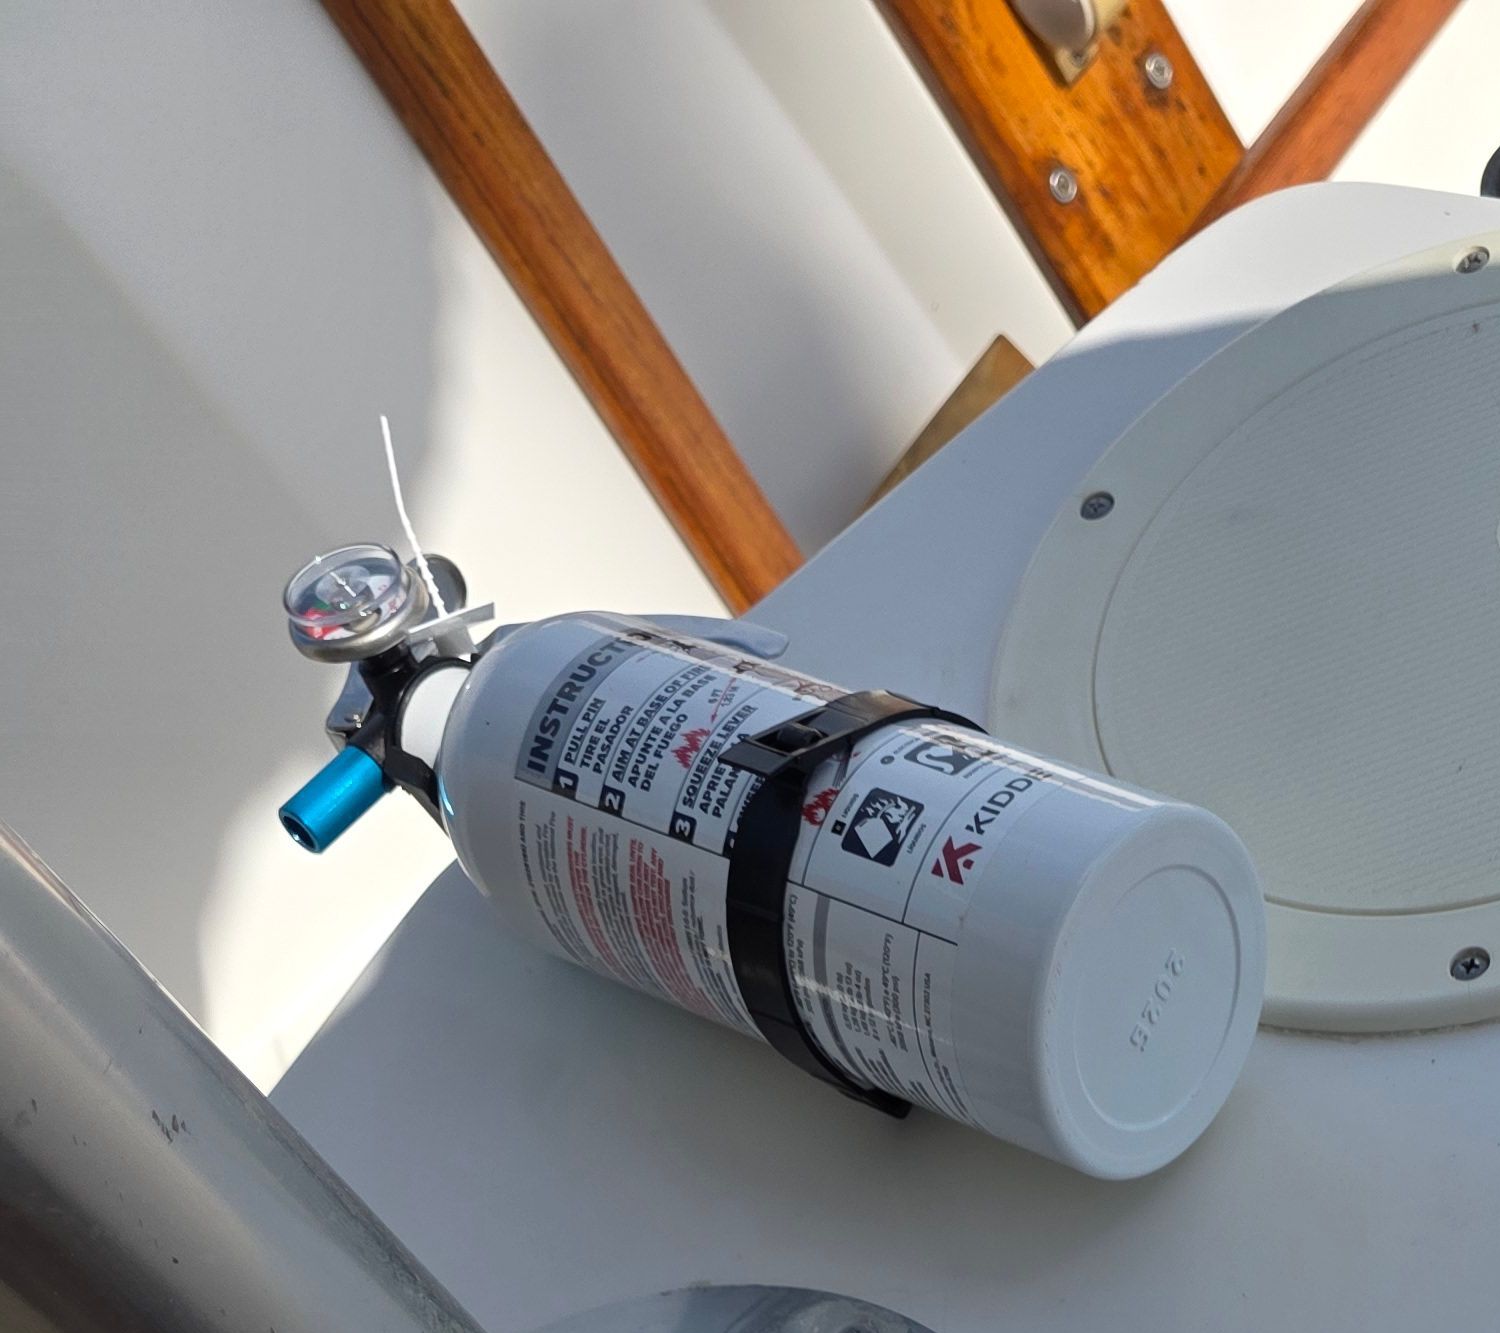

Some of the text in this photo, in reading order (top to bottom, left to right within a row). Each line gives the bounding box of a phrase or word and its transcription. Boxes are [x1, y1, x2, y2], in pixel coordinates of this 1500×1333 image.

[527, 634, 646, 774] INSTRUCT
[564, 698, 605, 766] PULL PIN
[611, 749, 631, 783] AIM
[625, 727, 641, 749] AT
[637, 694, 669, 728] BASE
[664, 679, 682, 695] OF
[627, 674, 718, 788] APUNTE A LA BASE
[580, 718, 611, 769] TIRE EL
[593, 705, 635, 774] PASADOR
[640, 713, 689, 792] DEL FUEGO
[682, 704, 758, 810] SQUEEZE LEVER
[604, 791, 620, 810] 2
[699, 764, 727, 816] APRIE
[711, 767, 742, 820] PALAN
[675, 818, 691, 838] 3
[1129, 947, 1186, 1053] 2025
